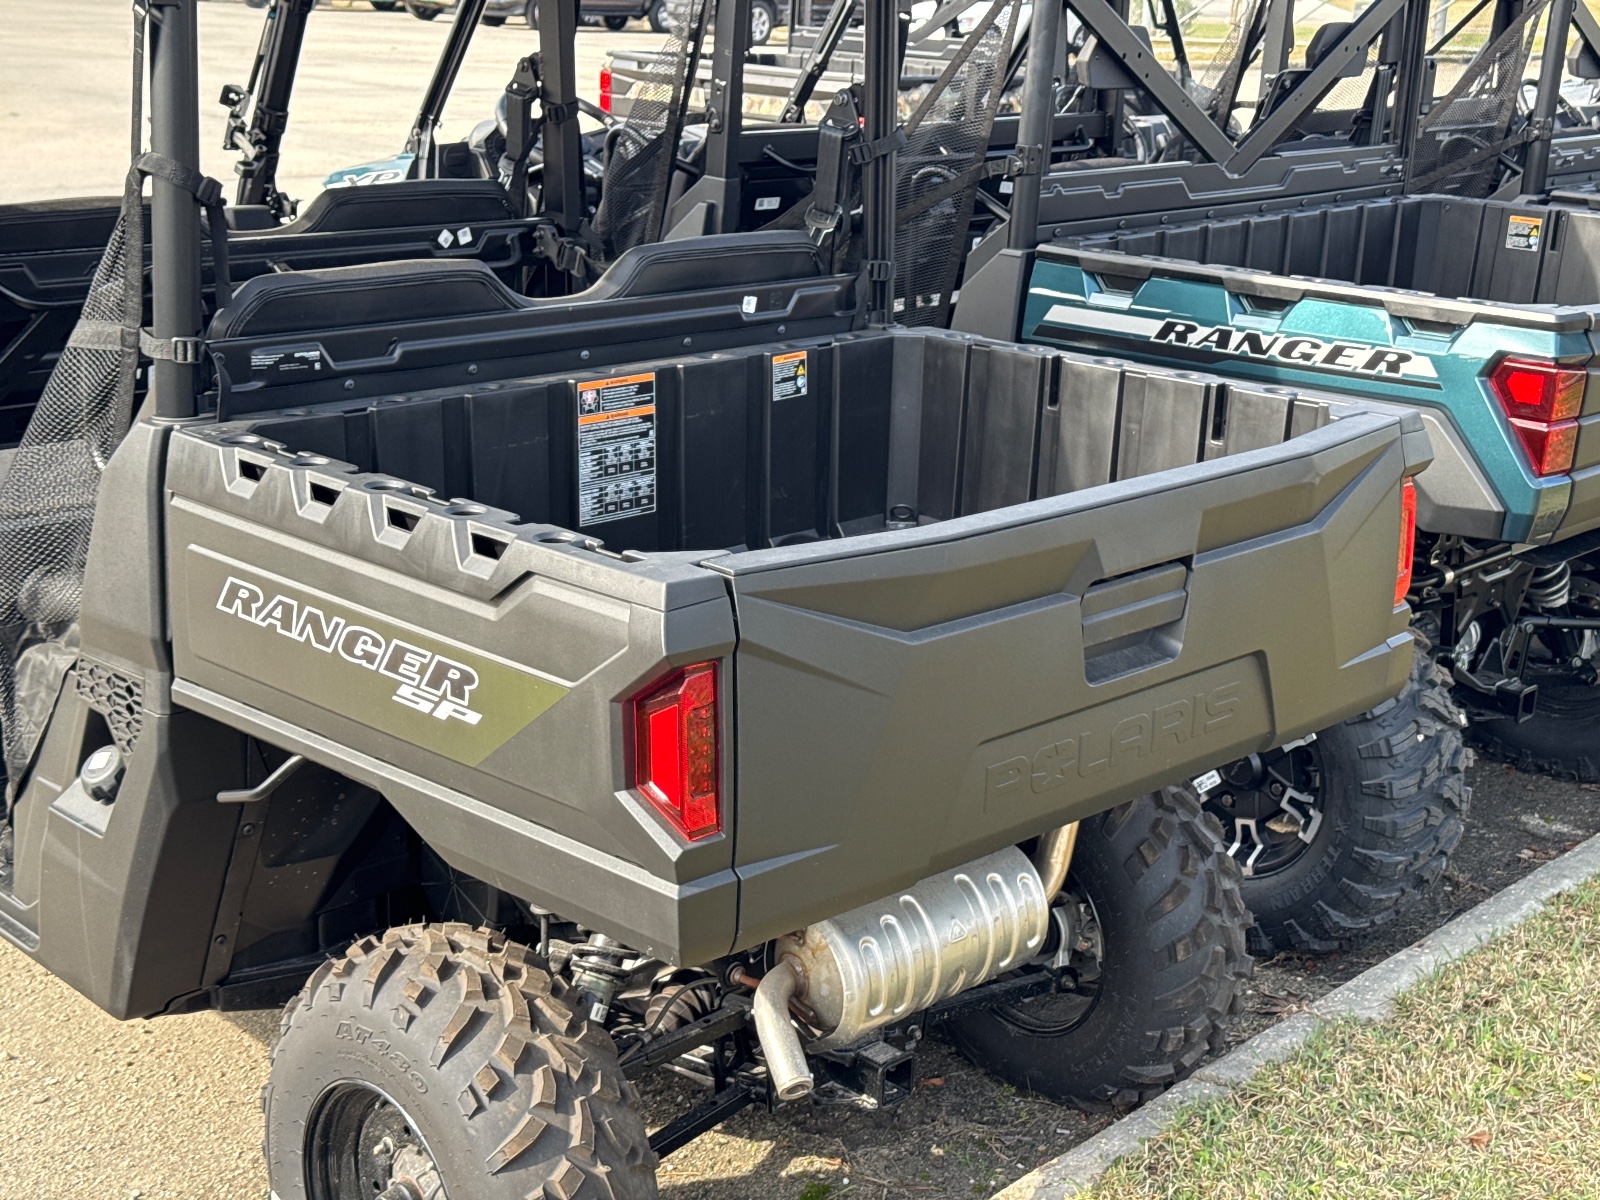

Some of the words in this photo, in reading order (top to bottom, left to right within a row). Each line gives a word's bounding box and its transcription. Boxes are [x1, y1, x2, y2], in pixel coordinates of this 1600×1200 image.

[1151, 319, 1414, 376] RANGER
[216, 576, 479, 706] RANGER
[391, 683, 483, 725] SP
[984, 681, 1239, 812] POLARIS
[335, 1020, 429, 1094] AT489
